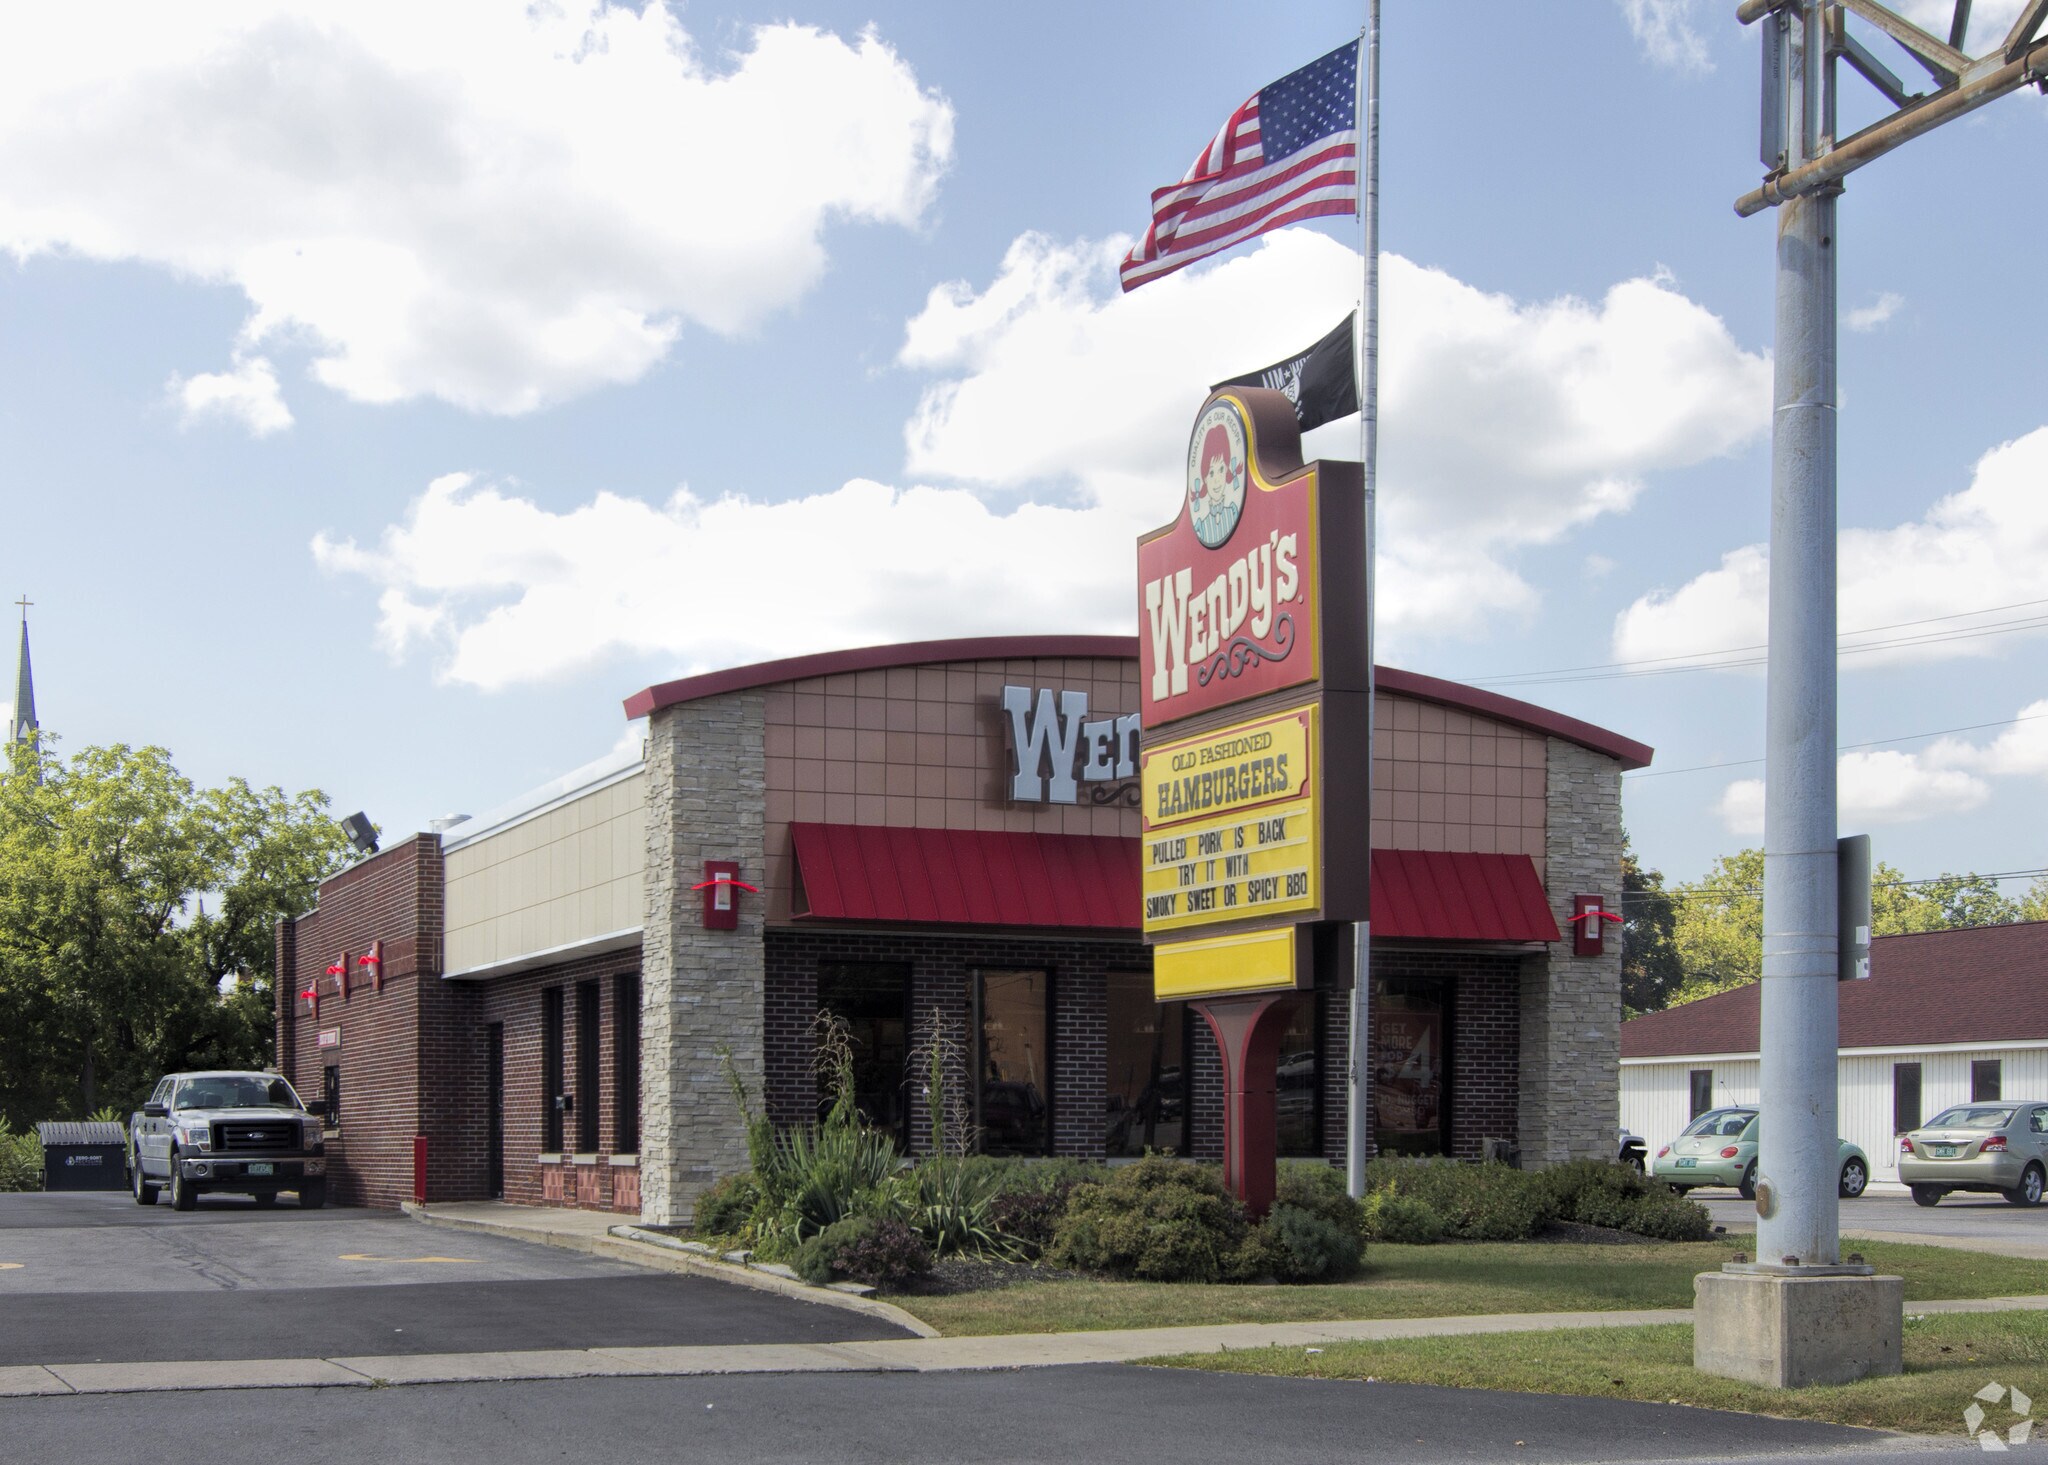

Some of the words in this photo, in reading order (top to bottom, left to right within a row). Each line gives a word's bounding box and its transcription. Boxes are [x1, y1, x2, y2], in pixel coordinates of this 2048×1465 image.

[1191, 424, 1206, 468] QUALITY
[1206, 415, 1213, 426] IS
[1213, 411, 1225, 421] OUR
[1226, 414, 1241, 447] RECIPE
[1172, 752, 1197, 773] OLD
[1199, 731, 1273, 767] FASHIONED
[1157, 753, 1289, 818] HAMBURGERS
[1152, 837, 1187, 865] PULLED
[1198, 830, 1223, 857] PORK
[1234, 826, 1245, 849] IS
[1258, 817, 1287, 845] BACK
[1178, 862, 1197, 887] TRY
[1206, 858, 1216, 883] IT
[1225, 853, 1250, 879] WITH
[1146, 893, 1177, 920] SMOKY
[1187, 887, 1217, 914] SWEET
[1224, 884, 1238, 908] OR
[1248, 876, 1279, 904] SPICY
[1286, 871, 1308, 898] BBQ
[1381, 1022, 1407, 1034] GET
[1381, 1035, 1413, 1050] MORE
[1397, 1094, 1435, 1106] NUGGET
